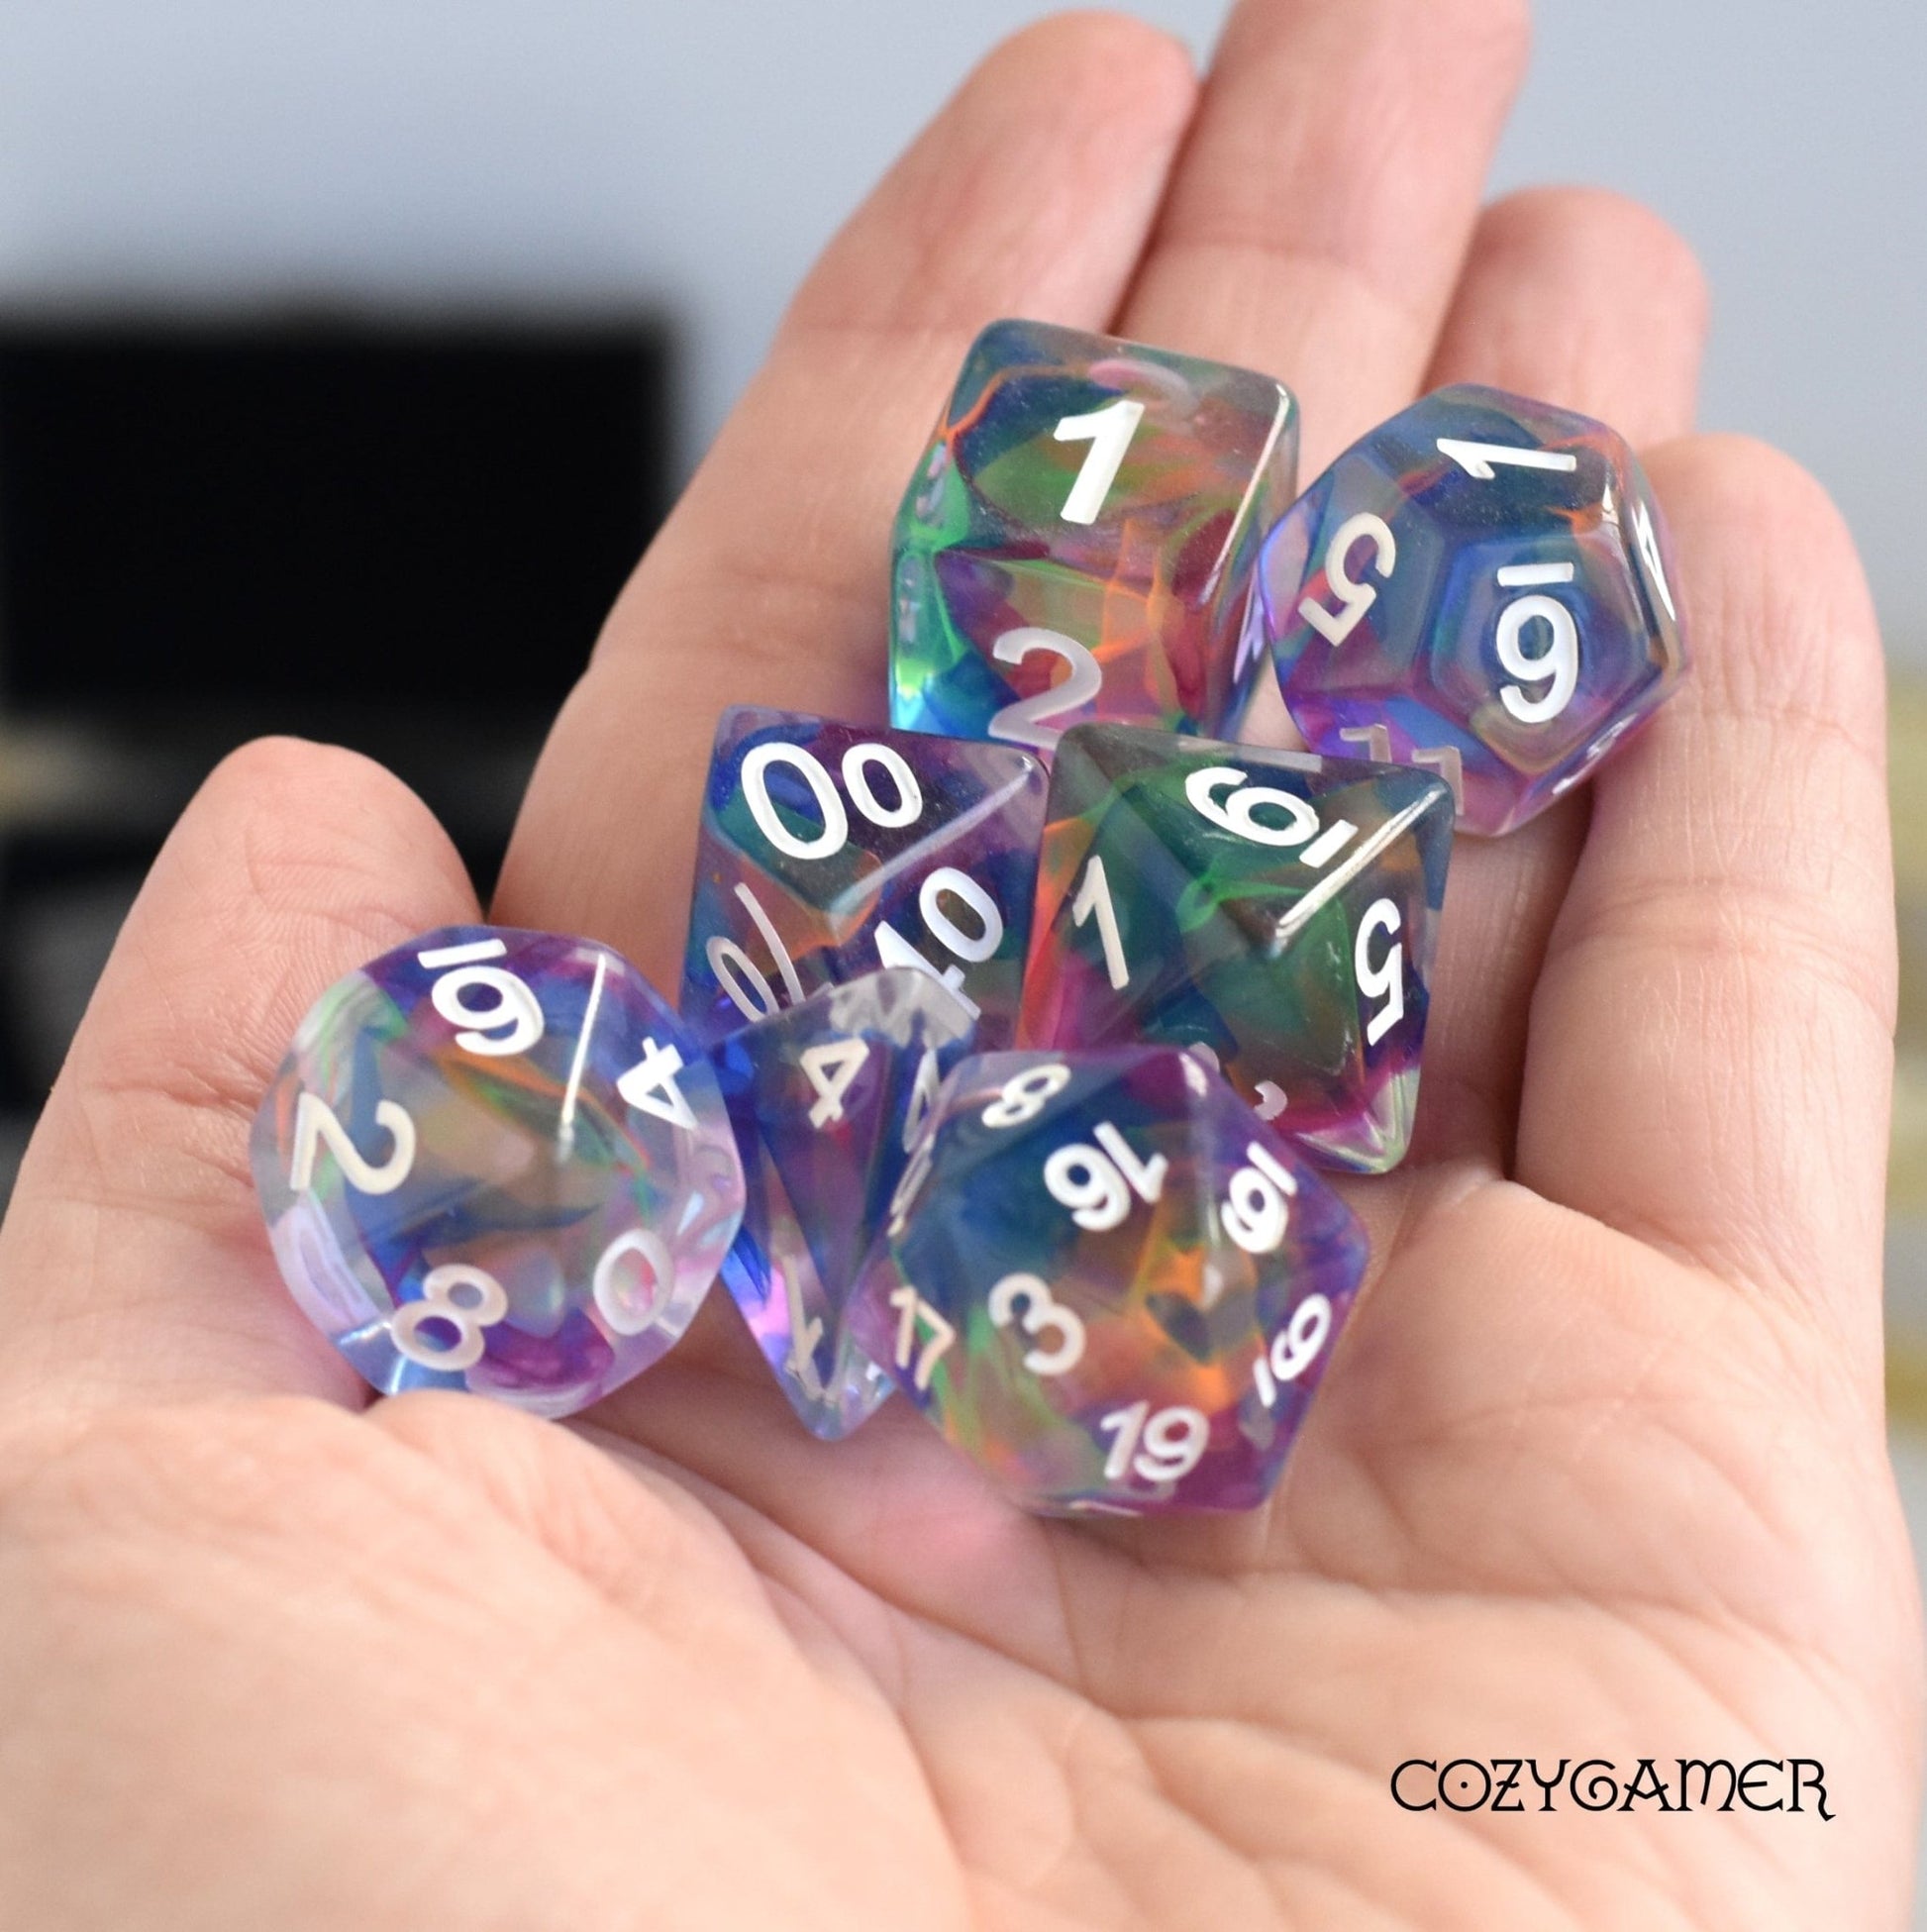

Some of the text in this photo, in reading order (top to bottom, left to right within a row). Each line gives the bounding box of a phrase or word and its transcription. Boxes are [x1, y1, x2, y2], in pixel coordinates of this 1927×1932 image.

[1054, 400, 1145, 525] 1
[1436, 438, 1576, 479] 1
[1298, 512, 1396, 647] 5
[987, 627, 1102, 752] 2
[741, 742, 923, 860] 00
[1072, 855, 1130, 990] 1
[1355, 898, 1405, 1047] 5
[617, 1037, 697, 1130] 4
[800, 1037, 870, 1130] 4
[982, 1064, 1071, 1128] 8
[290, 1092, 416, 1194] 2
[1044, 1121, 1168, 1231] 16
[391, 1264, 507, 1371] 8
[988, 1272, 1085, 1375] 3
[1100, 1400, 1210, 1481] 19
